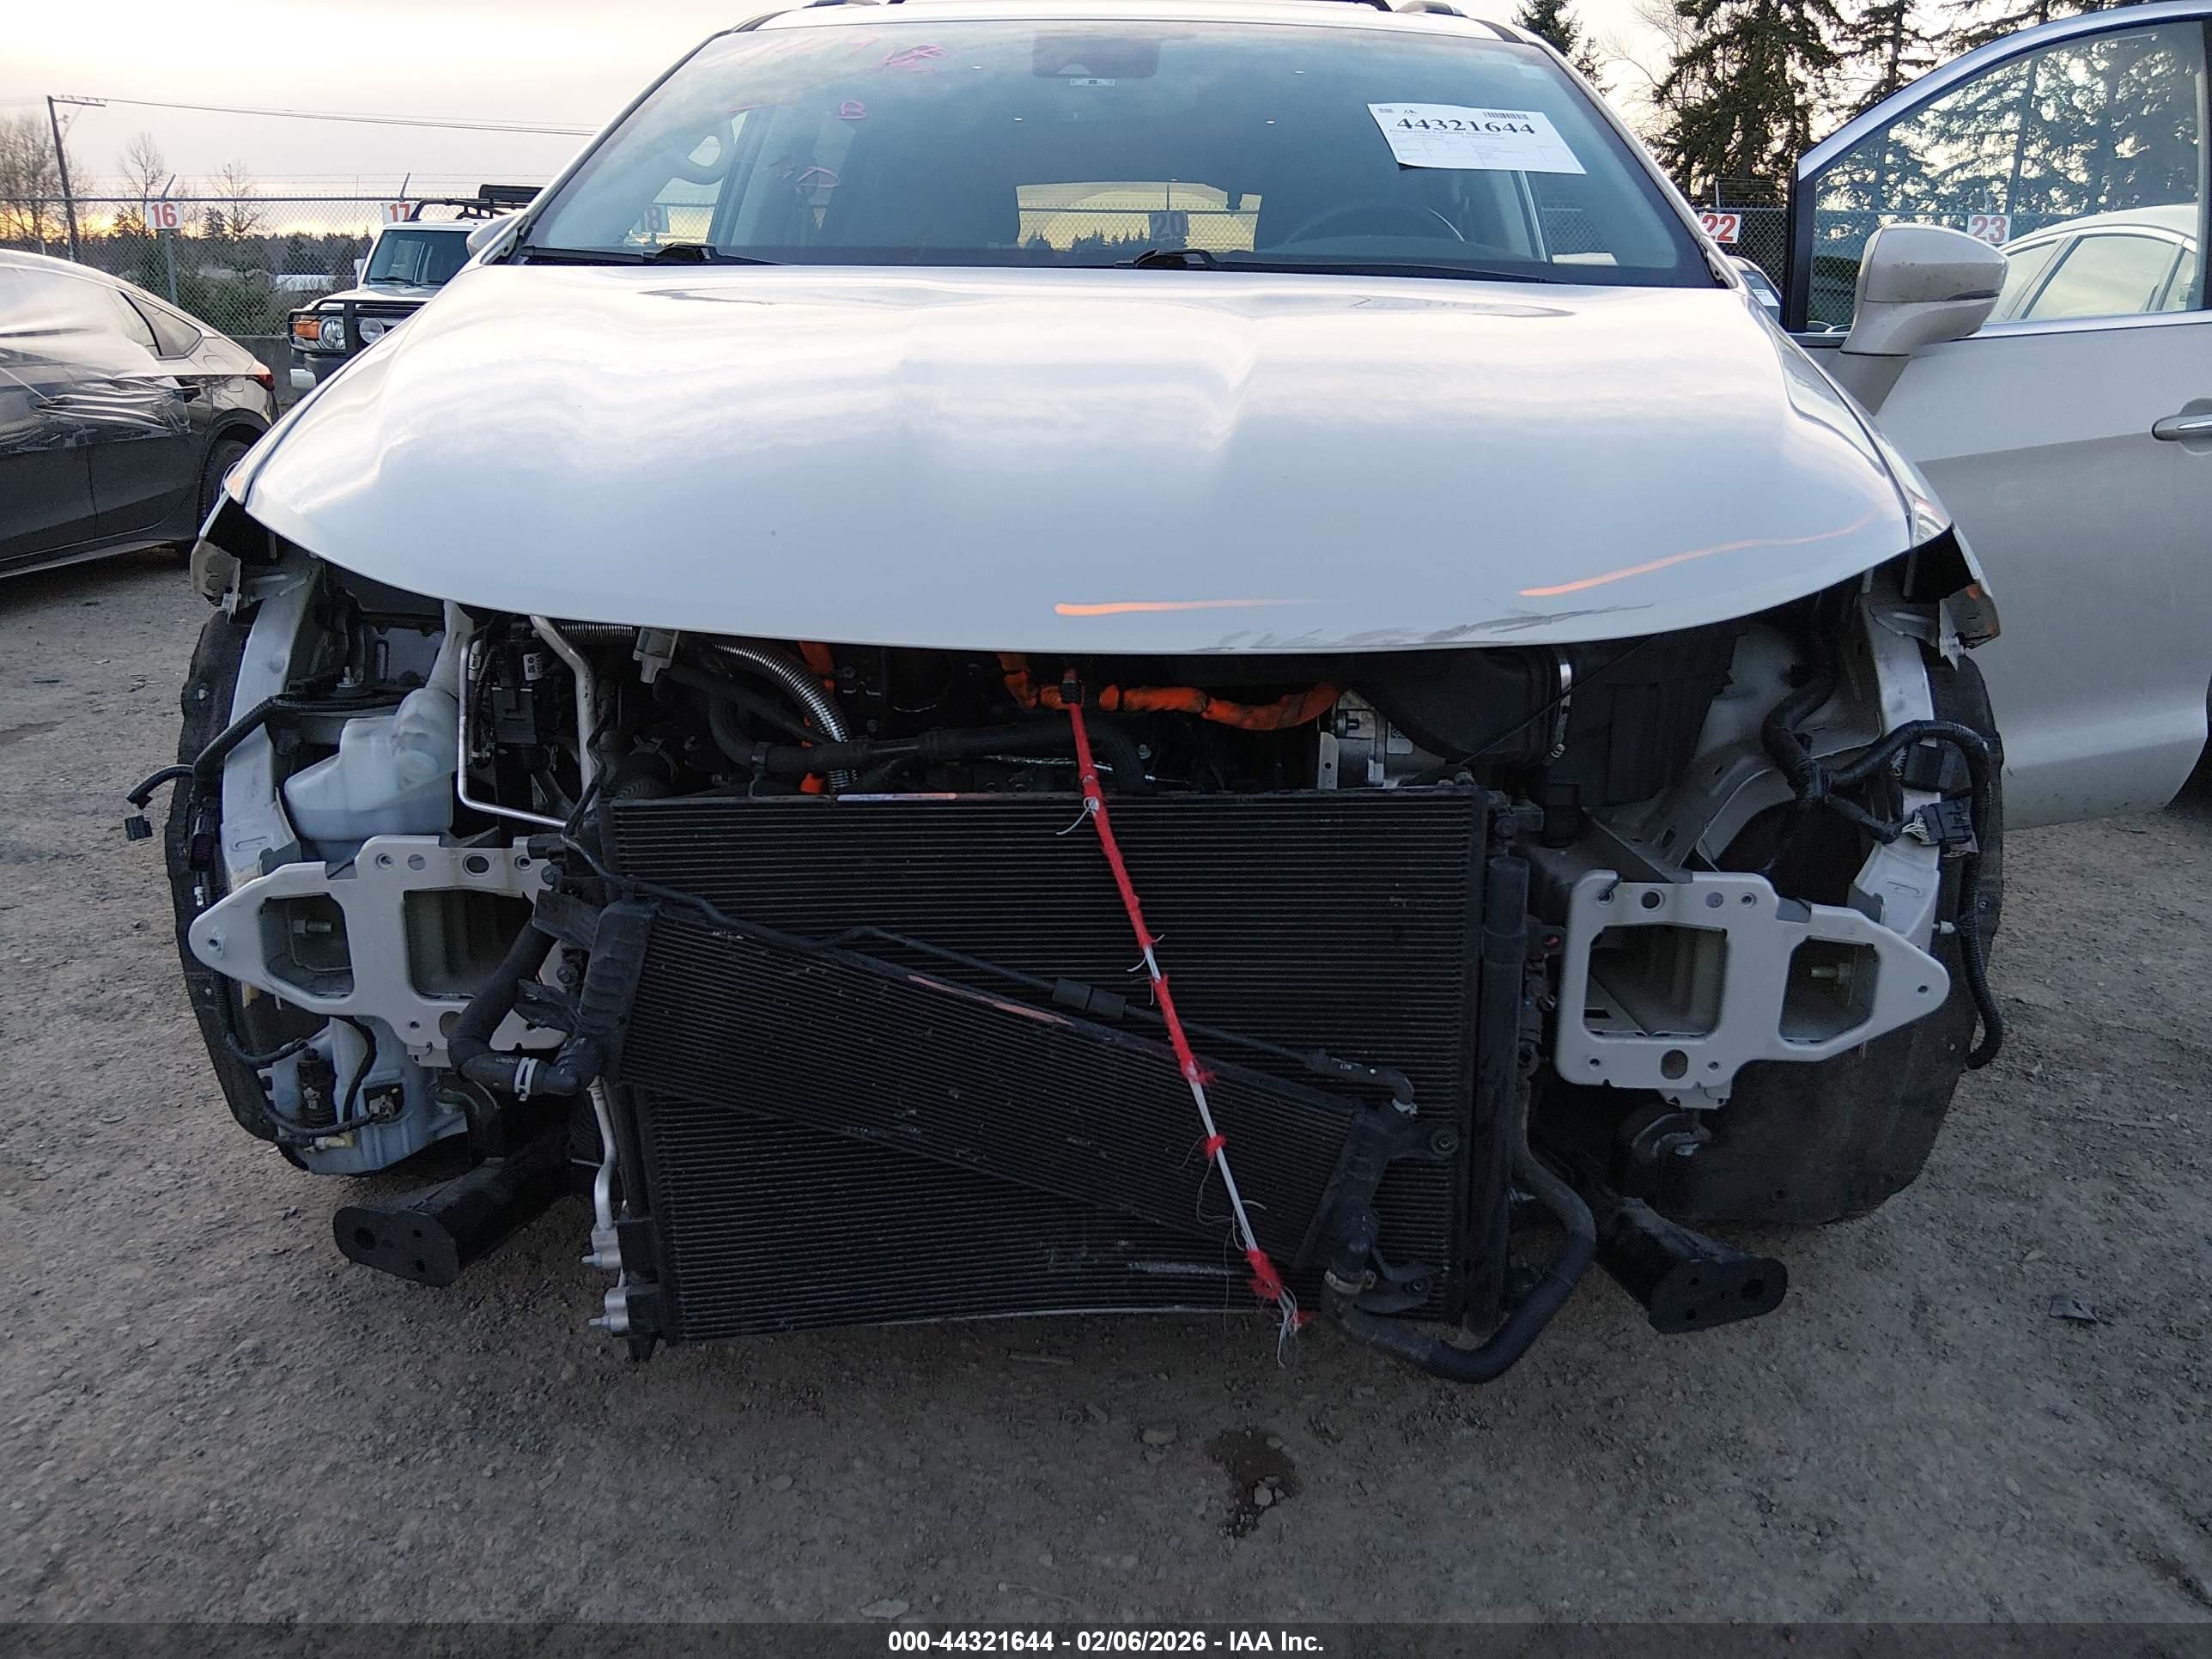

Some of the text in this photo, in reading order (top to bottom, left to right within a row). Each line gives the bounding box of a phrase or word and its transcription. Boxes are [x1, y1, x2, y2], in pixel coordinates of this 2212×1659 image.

[1396, 117, 1535, 135] 44321644
[152, 204, 177, 228] 16
[390, 204, 410, 222] 17
[1153, 215, 1186, 240] 20
[1702, 215, 1736, 242] 22
[1971, 216, 2006, 243] 23
